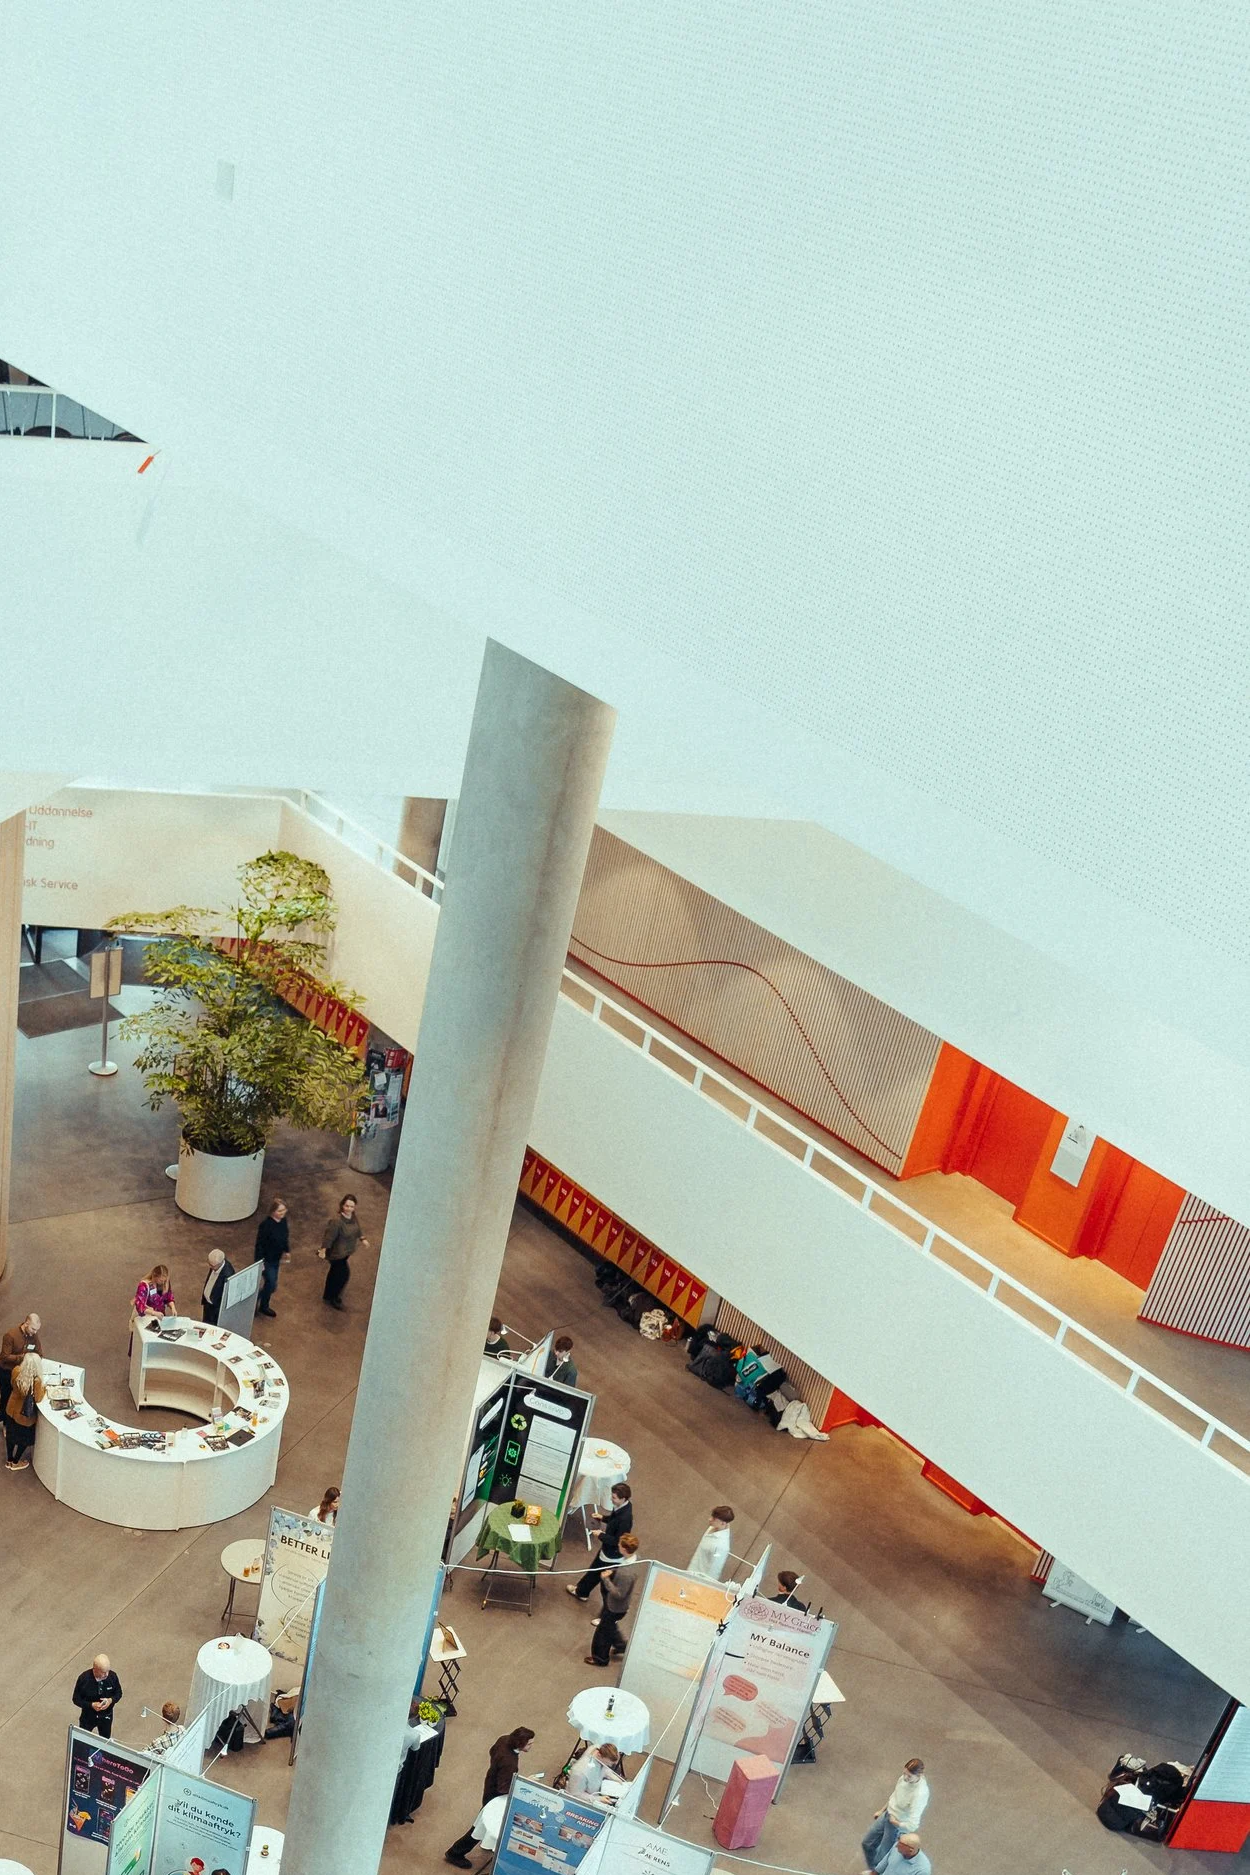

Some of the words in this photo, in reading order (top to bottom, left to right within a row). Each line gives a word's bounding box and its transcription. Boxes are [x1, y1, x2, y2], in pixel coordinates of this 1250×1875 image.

[41, 878, 79, 890] Service
[280, 1535, 318, 1556] BETTER
[771, 1609, 790, 1623] MY
[791, 1615, 821, 1632] Grace
[750, 1632, 767, 1644] MY
[769, 1638, 810, 1659] Balance
[167, 1804, 180, 1814] dit
[183, 1808, 242, 1839] klimaaftryk?
[190, 1804, 203, 1815] du
[205, 1809, 235, 1828] kende
[565, 1810, 600, 1827] BREAKING
[576, 1820, 596, 1831] NEWS
[646, 1843, 668, 1856] AME
